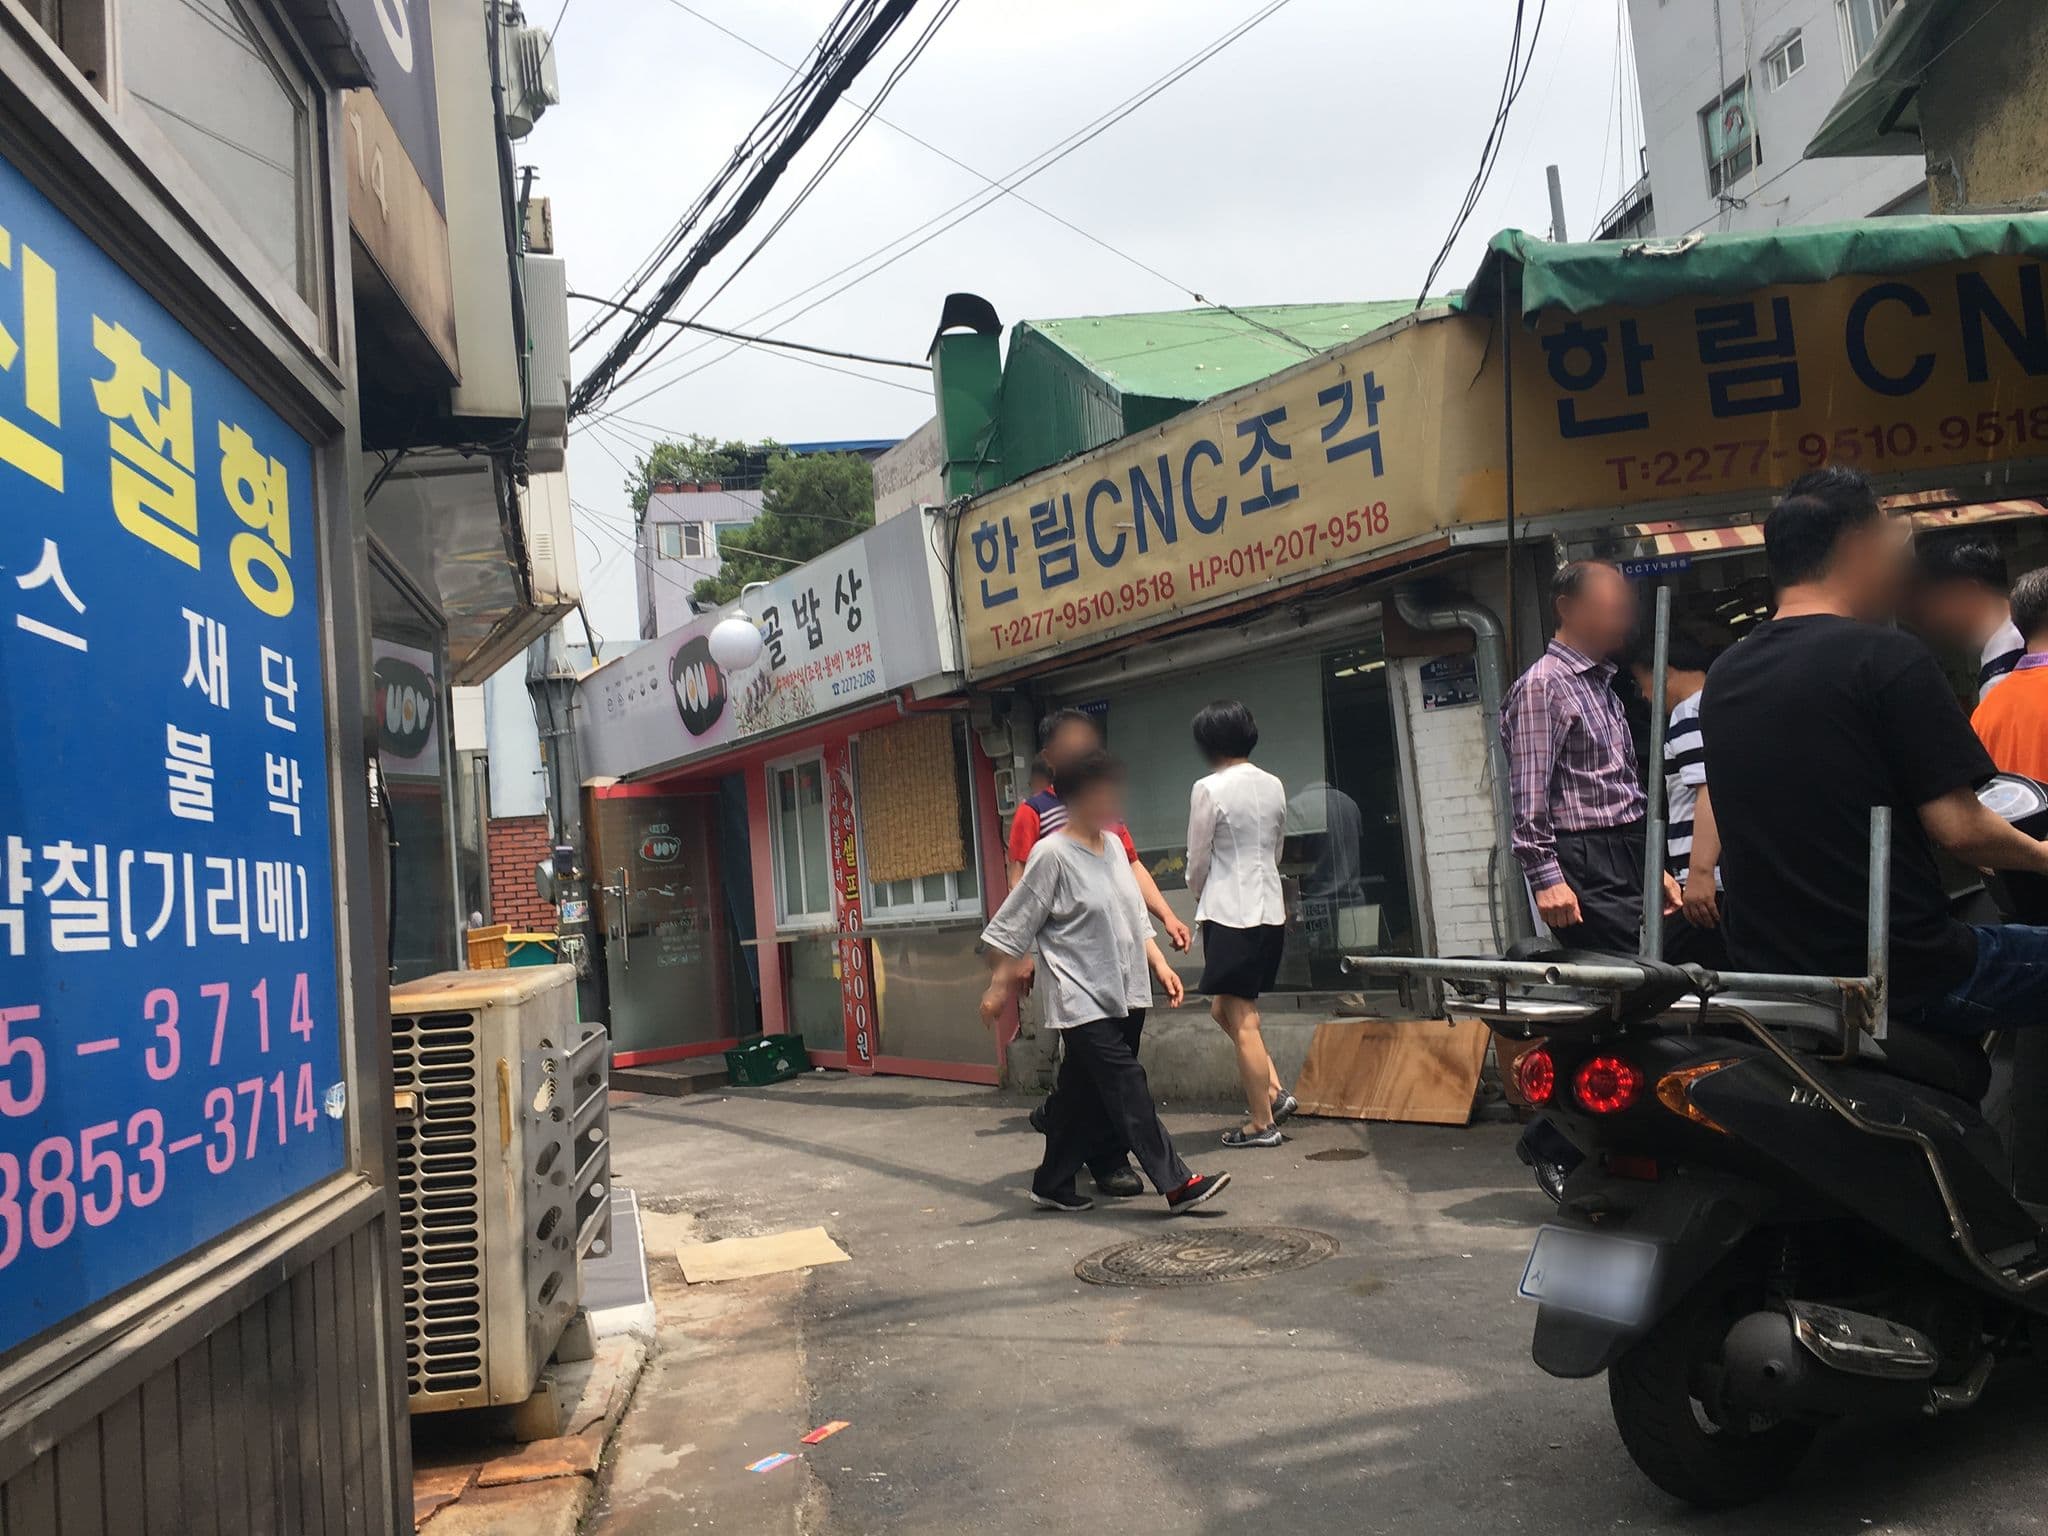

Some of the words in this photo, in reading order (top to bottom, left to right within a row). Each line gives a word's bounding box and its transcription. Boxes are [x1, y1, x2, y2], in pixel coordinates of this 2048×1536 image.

[971, 370, 1386, 610] 한림CNC조각
[762, 568, 862, 672] 골밥상
[990, 570, 1176, 652] T:2277-9510.9518
[1188, 501, 1390, 594] H.P:011-207-9518
[842, 668, 876, 694] 2272-2268
[842, 833, 859, 900] 셀프
